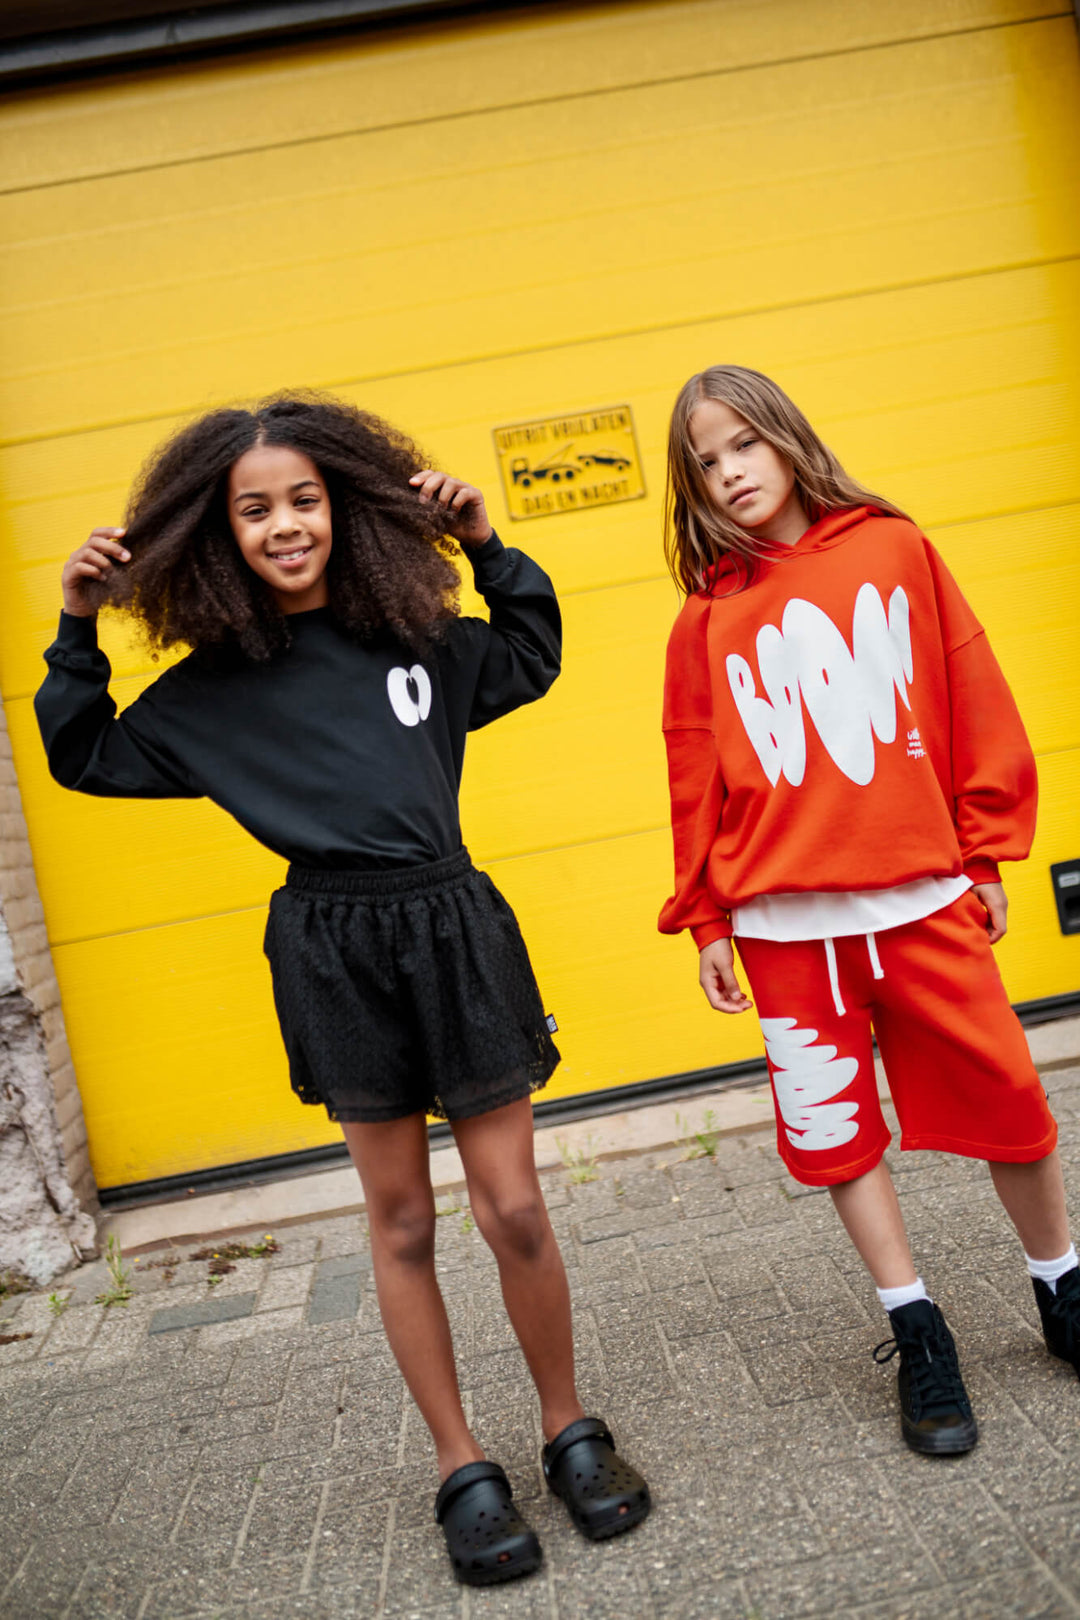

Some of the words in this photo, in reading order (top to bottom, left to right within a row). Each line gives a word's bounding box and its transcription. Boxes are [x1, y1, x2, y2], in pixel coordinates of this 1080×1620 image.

[499, 425, 547, 448] UITRIT
[521, 492, 554, 514] DAG
[557, 489, 577, 508] EN
[580, 480, 629, 504] NACHT
